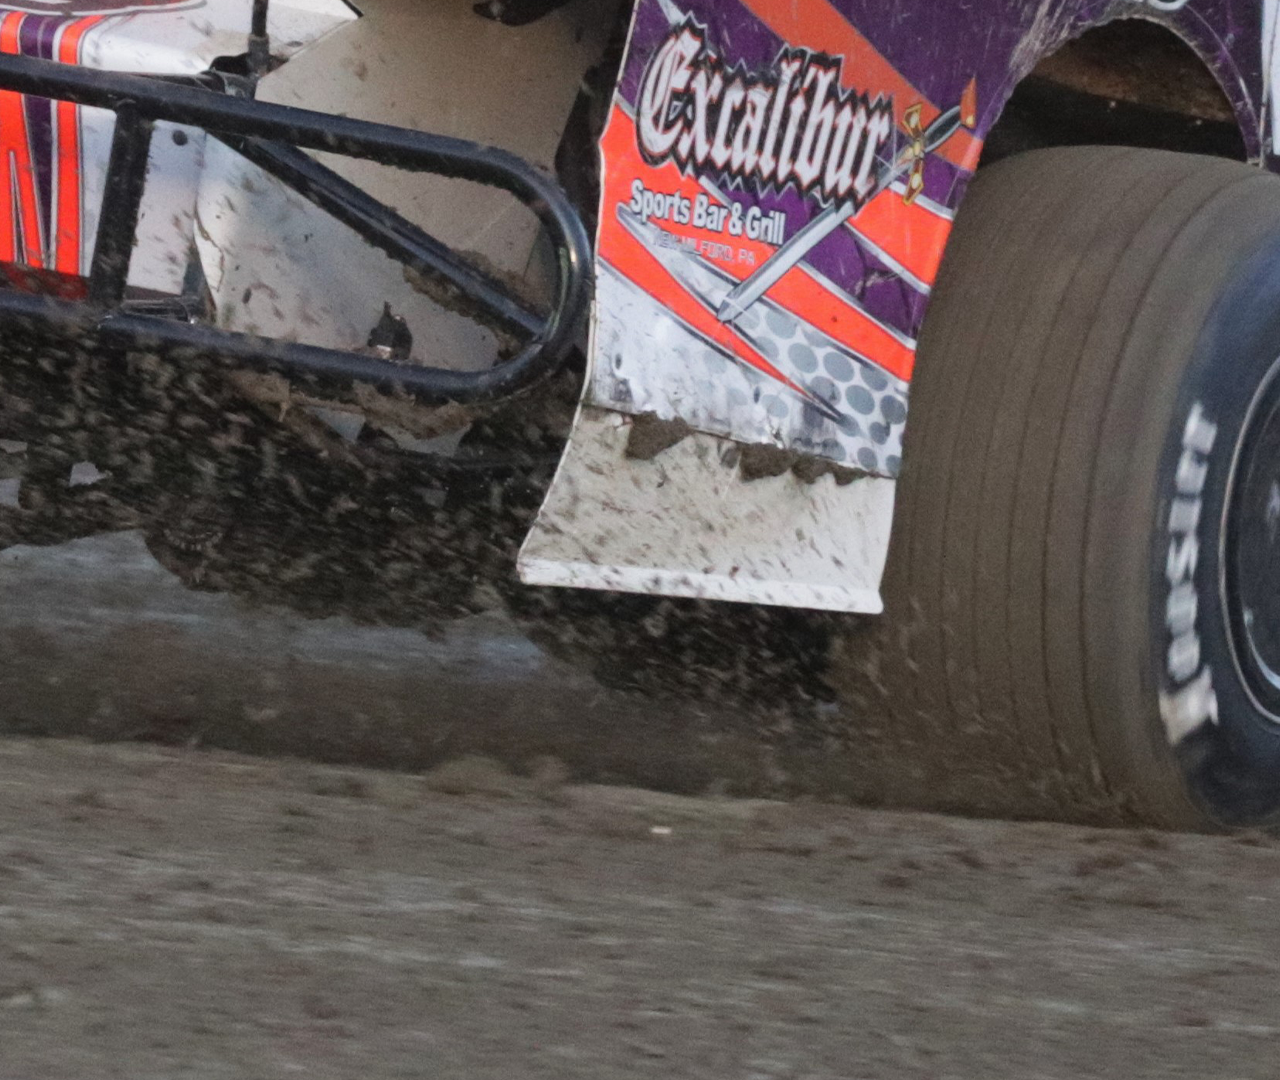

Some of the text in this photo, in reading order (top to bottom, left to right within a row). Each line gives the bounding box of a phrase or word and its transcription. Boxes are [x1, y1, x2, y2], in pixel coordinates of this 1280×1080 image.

[638, 23, 892, 198] Excalibur
[630, 178, 787, 246] Sports Bar & Grill
